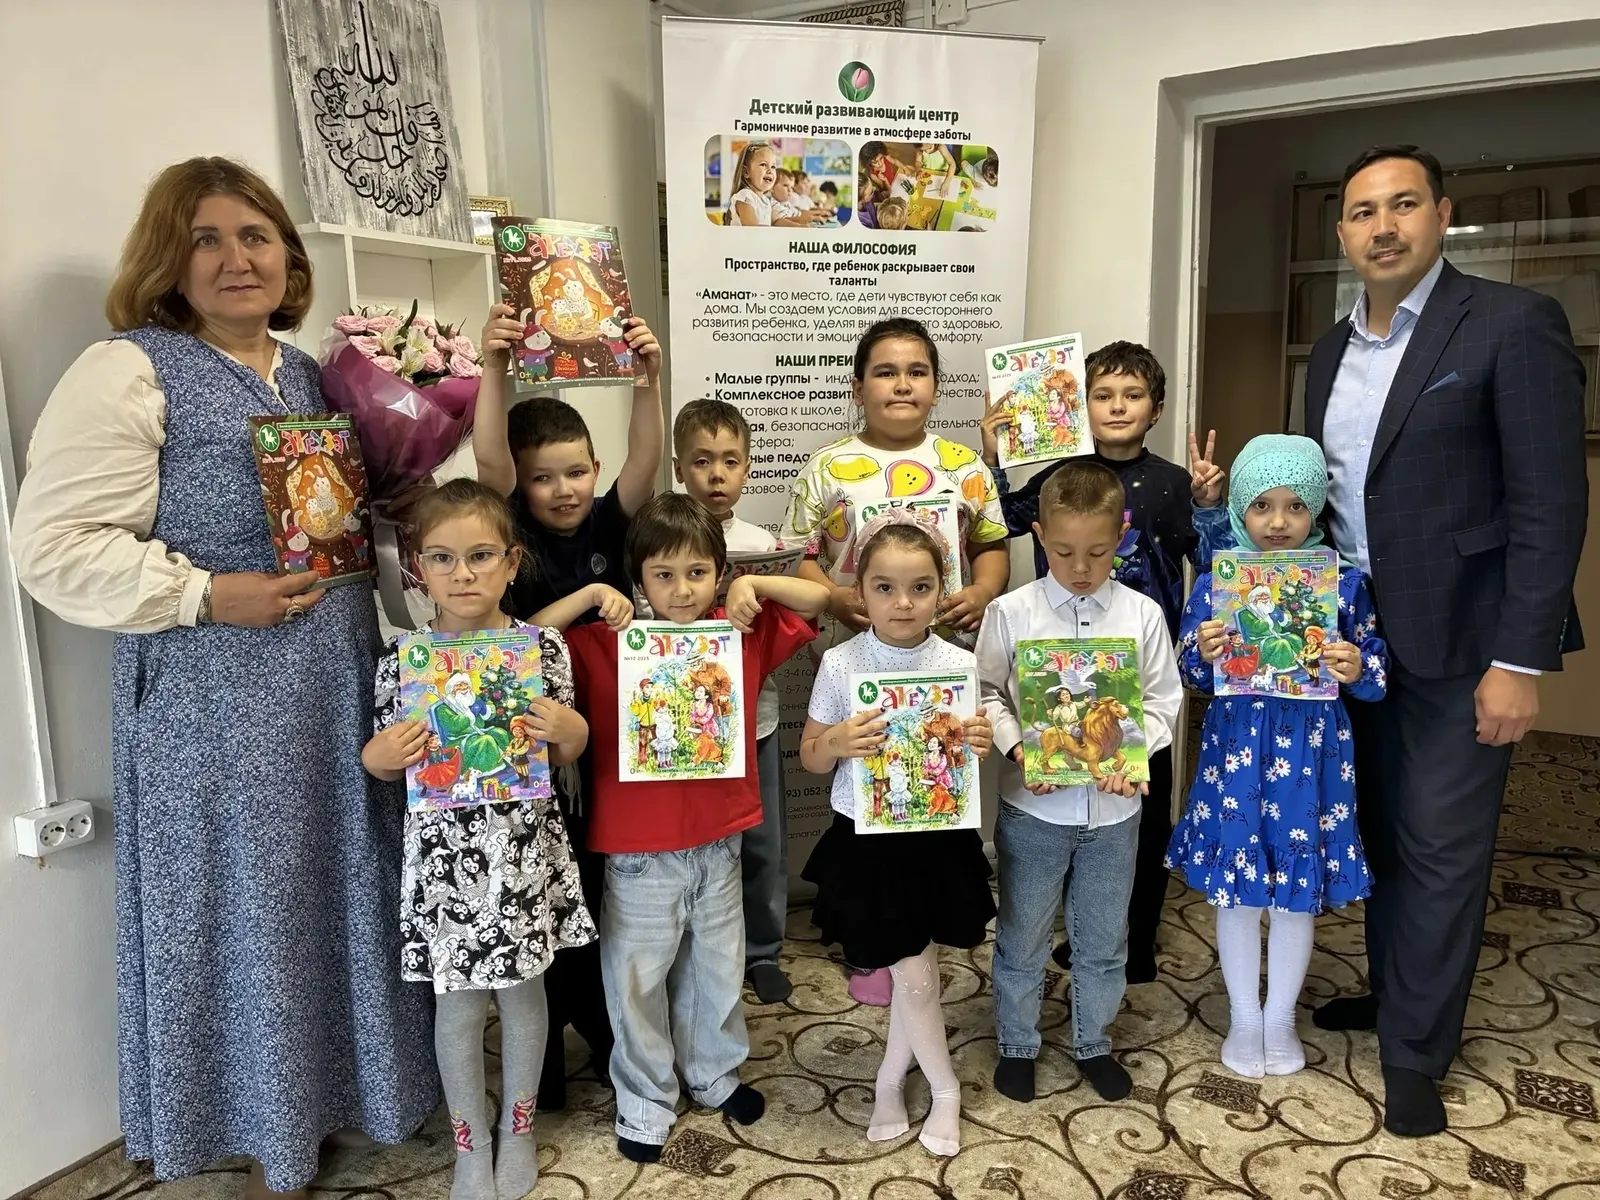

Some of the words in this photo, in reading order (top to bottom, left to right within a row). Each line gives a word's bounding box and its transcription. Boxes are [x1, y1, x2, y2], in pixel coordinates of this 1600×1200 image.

[749, 99, 812, 115] Детский
[816, 105, 915, 121] развивающий
[919, 110, 958, 125] центр
[735, 120, 809, 133] Гармоничное
[812, 126, 861, 136] развитие
[873, 127, 931, 140] атмосфере
[934, 129, 970, 140] заботы
[789, 242, 830, 253] НАША
[832, 243, 916, 255] ФИЛОСОФИЯ
[725, 258, 809, 272] Пространство,
[813, 262, 831, 272] где
[834, 260, 879, 273] ребенок
[882, 263, 948, 274] раскрывает
[951, 265, 974, 273] свои
[829, 278, 876, 286] таланты
[696, 288, 757, 299] «Аманат»
[768, 292, 788, 300] это
[791, 292, 832, 301] место,
[836, 292, 855, 302] где
[858, 293, 885, 302] дети
[888, 293, 947, 304] чувствуют
[950, 291, 978, 302] себя
[981, 294, 1001, 302] как
[704, 305, 741, 315] дома.
[746, 303, 766, 314] Мы
[769, 305, 824, 316] создаем
[828, 306, 876, 317] условия
[879, 307, 898, 316] для
[902, 307, 992, 317] всестороннего
[693, 319, 748, 329] развития
[752, 317, 809, 330] ребенка,
[813, 320, 855, 330] уделяя
[943, 320, 1002, 331] здоровью,
[713, 331, 803, 342] безопасности
[806, 333, 813, 341] и
[776, 355, 816, 367] НАШИ
[715, 373, 762, 384] Малые
[766, 375, 810, 386] группы
[715, 388, 806, 402] Комплексное
[791, 407, 797, 415] к
[801, 406, 846, 416] школе;
[770, 420, 849, 432] безопасная
